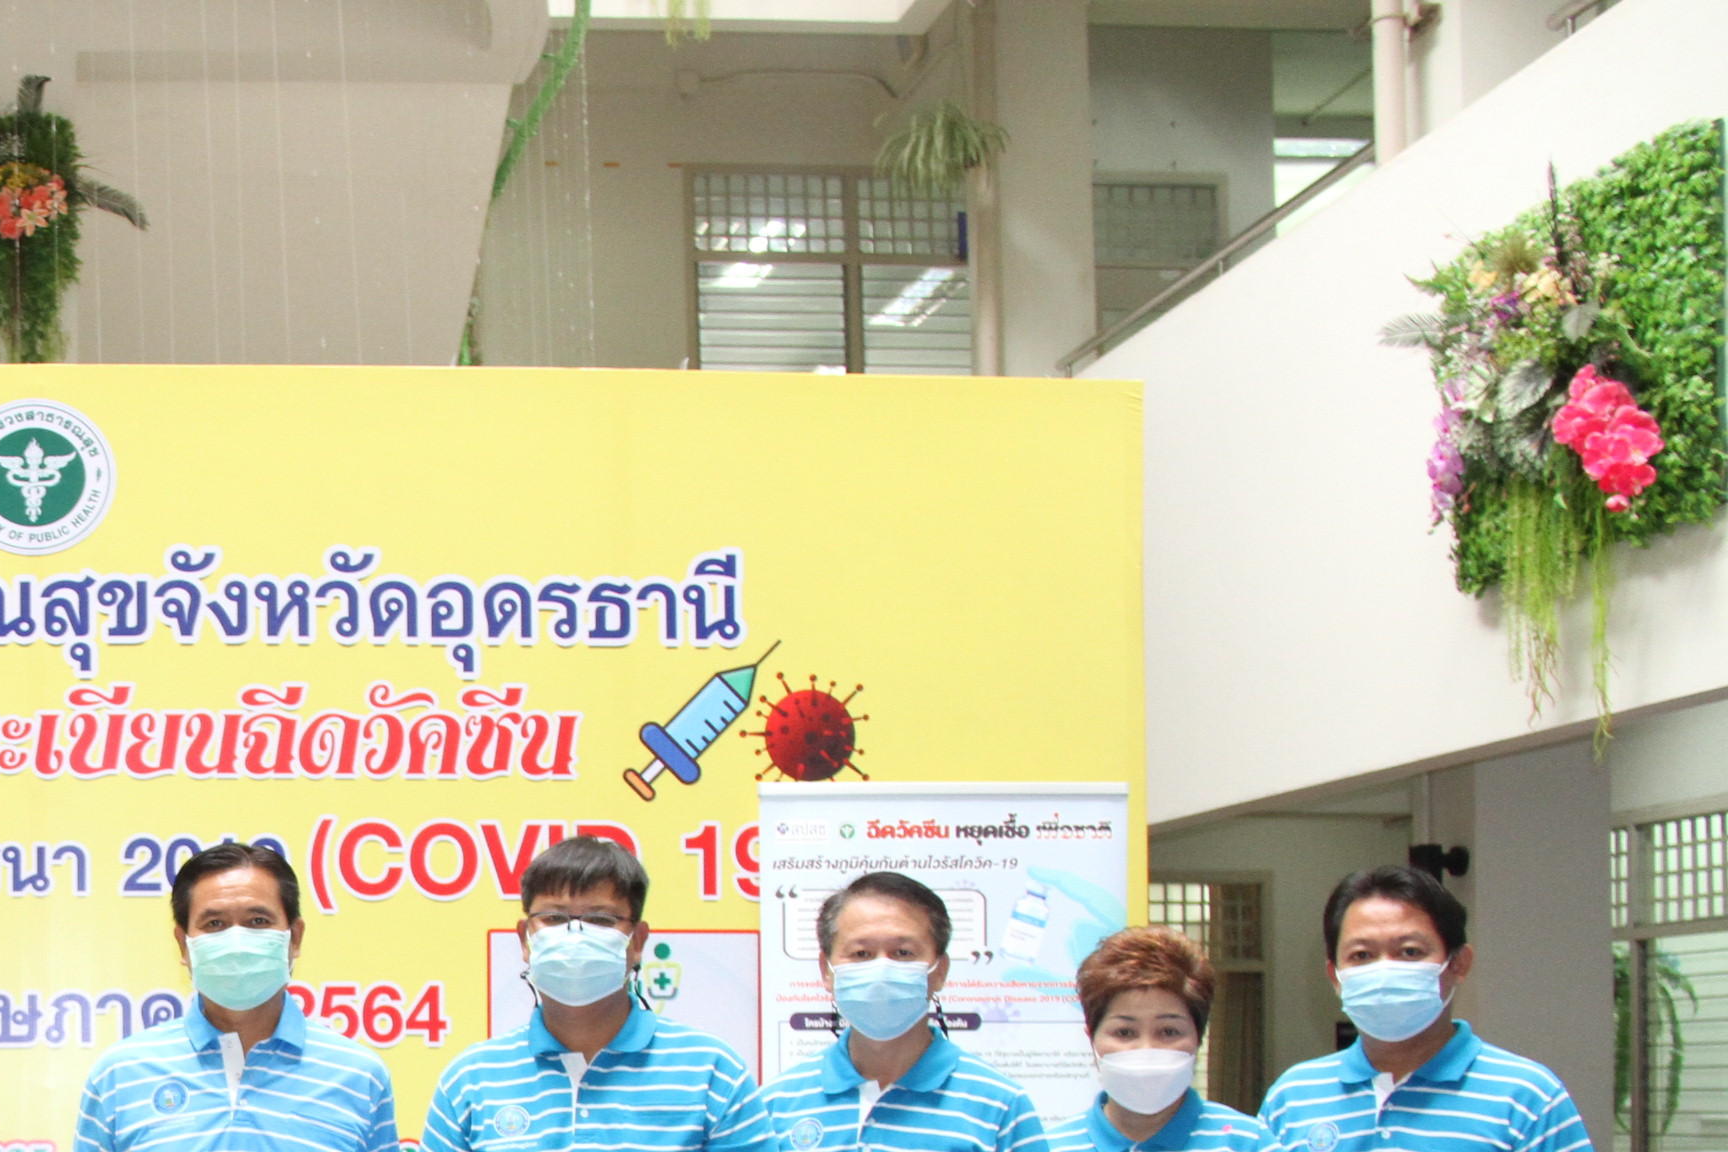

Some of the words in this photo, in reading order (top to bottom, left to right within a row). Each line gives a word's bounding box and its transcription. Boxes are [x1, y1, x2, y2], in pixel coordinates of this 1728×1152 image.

[8, 529, 25, 542] OF
[28, 527, 71, 543] PUBLIC
[71, 488, 102, 529] HEALTH
[866, 818, 951, 840] ฉีดวัคซีน
[955, 812, 1031, 846] หยุดเชื้อ
[124, 838, 286, 891] 20
